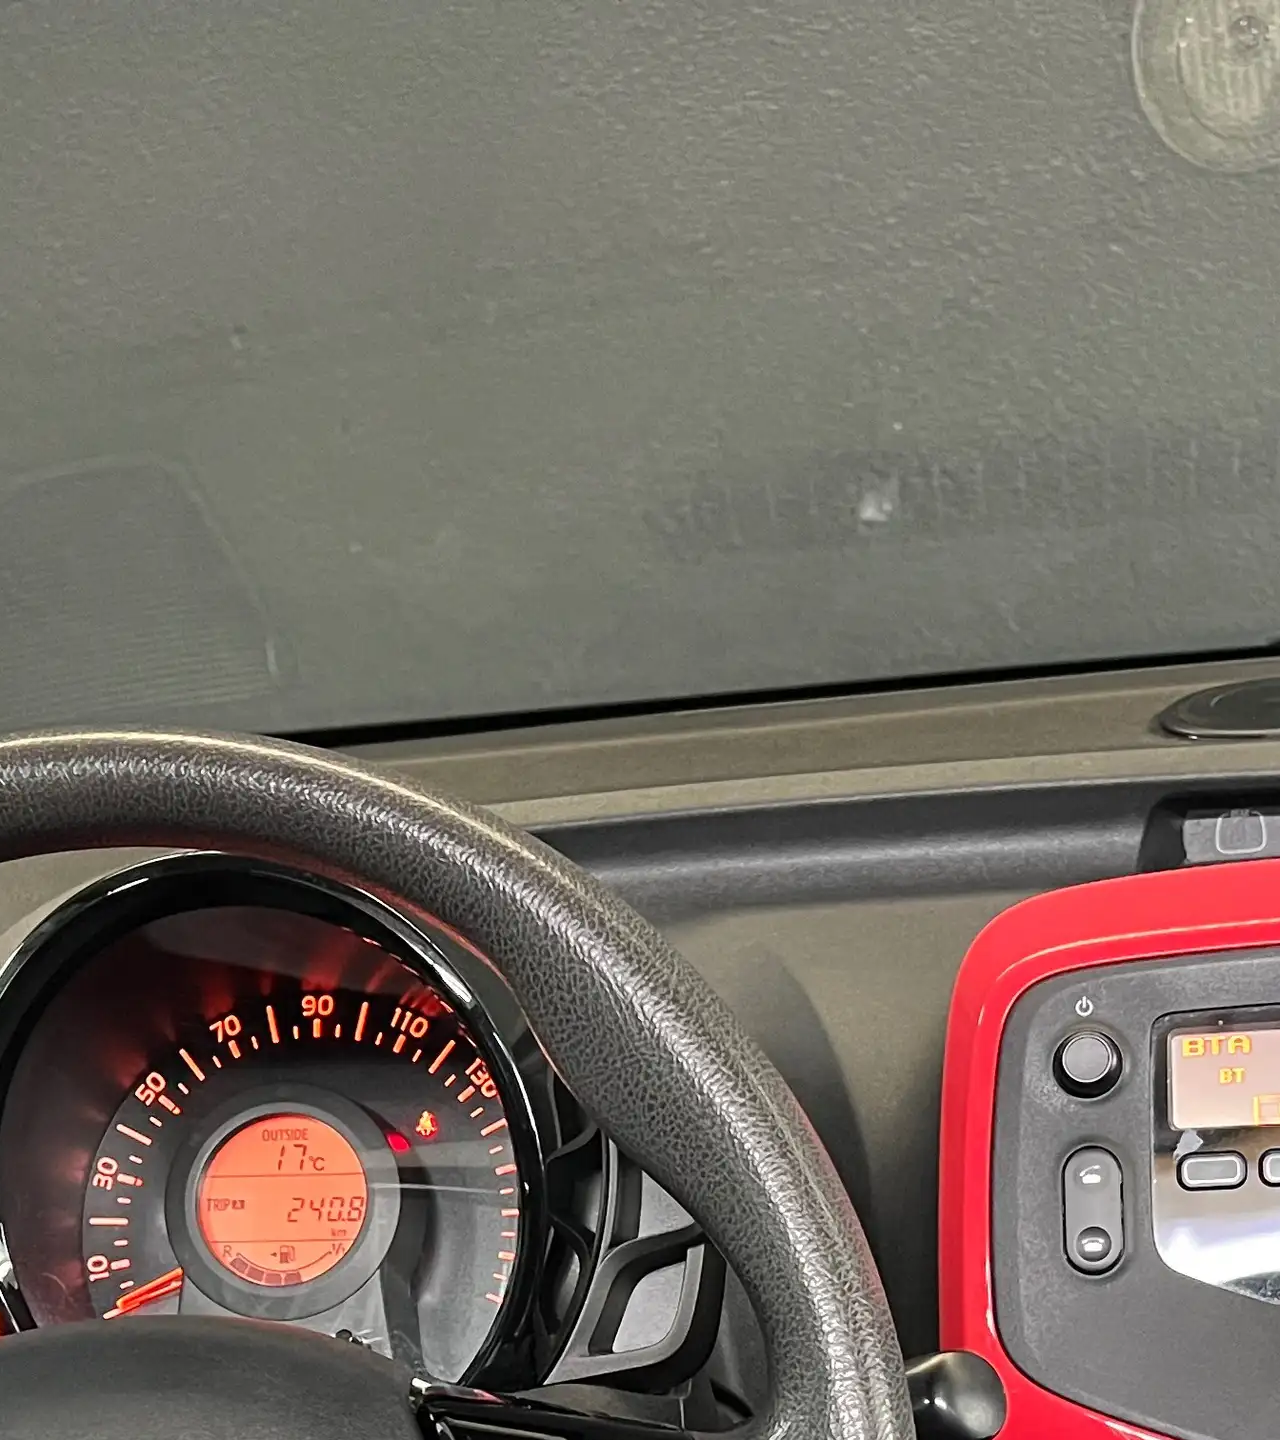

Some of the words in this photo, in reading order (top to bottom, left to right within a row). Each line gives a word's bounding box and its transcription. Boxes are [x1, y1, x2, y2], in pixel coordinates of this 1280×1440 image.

[301, 994, 335, 1017] 90
[209, 1014, 242, 1043] 70
[390, 1006, 429, 1039] 110
[1181, 1034, 1253, 1058] BTA
[134, 1071, 167, 1107] 50
[465, 1056, 498, 1099] 130
[1218, 1067, 1246, 1085] BT
[261, 1128, 310, 1142] OUTSIDE
[92, 1156, 119, 1191] 30
[206, 1198, 231, 1212] TRIP
[286, 1195, 365, 1223] 240.8
[330, 1227, 348, 1237] km
[222, 1244, 232, 1258] R
[85, 1254, 110, 1282] 10
